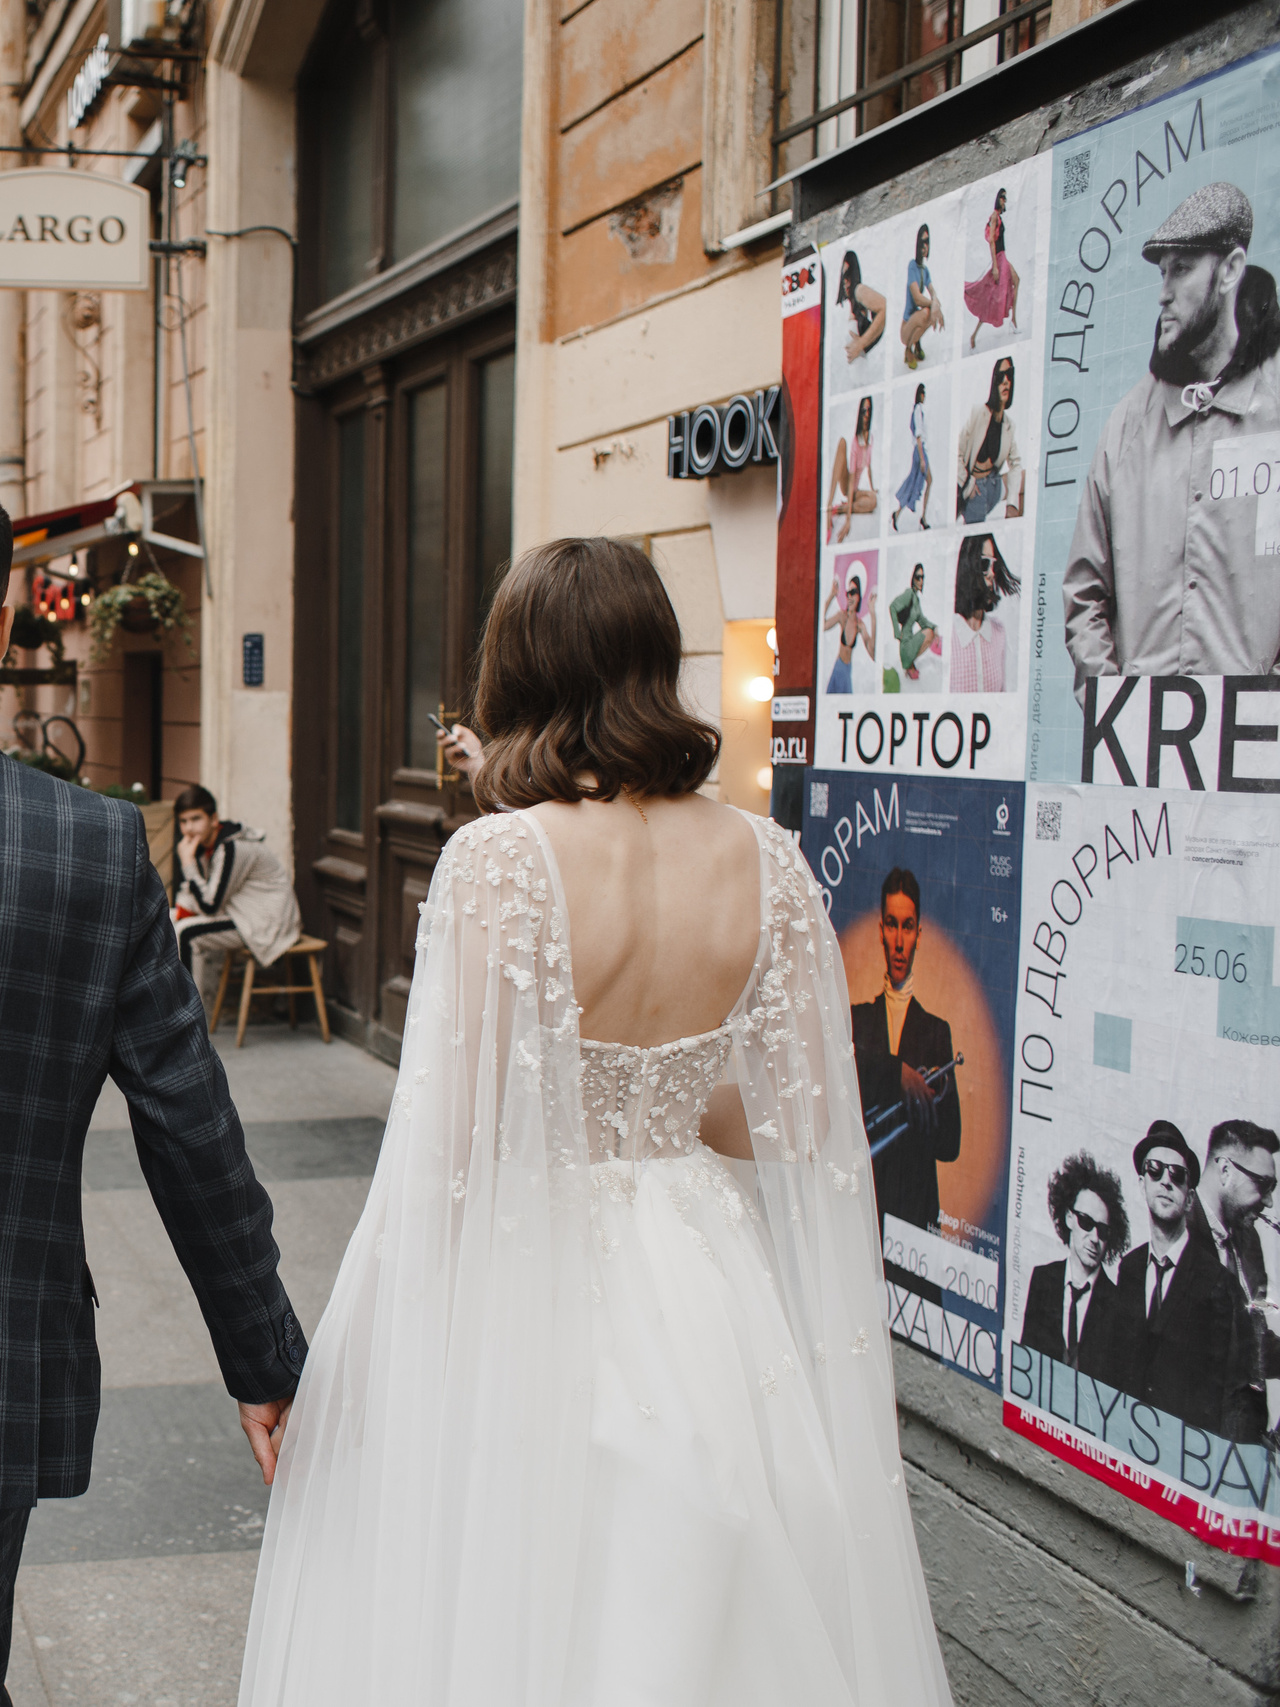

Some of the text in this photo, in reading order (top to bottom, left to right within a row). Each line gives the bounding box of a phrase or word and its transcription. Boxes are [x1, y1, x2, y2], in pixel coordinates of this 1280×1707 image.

[1050, 97, 1207, 374] ДВОРАМ
[837, 711, 991, 769] TOPTOP
[1081, 674, 1280, 794] KRE
[990, 906, 1008, 923] 16+
[1024, 801, 1173, 1019] ДВОРАМ
[1174, 943, 1248, 983] 25.06
[884, 1236, 998, 1311] 23.06 20:00
[1010, 1339, 1161, 1466] BILLY'S
